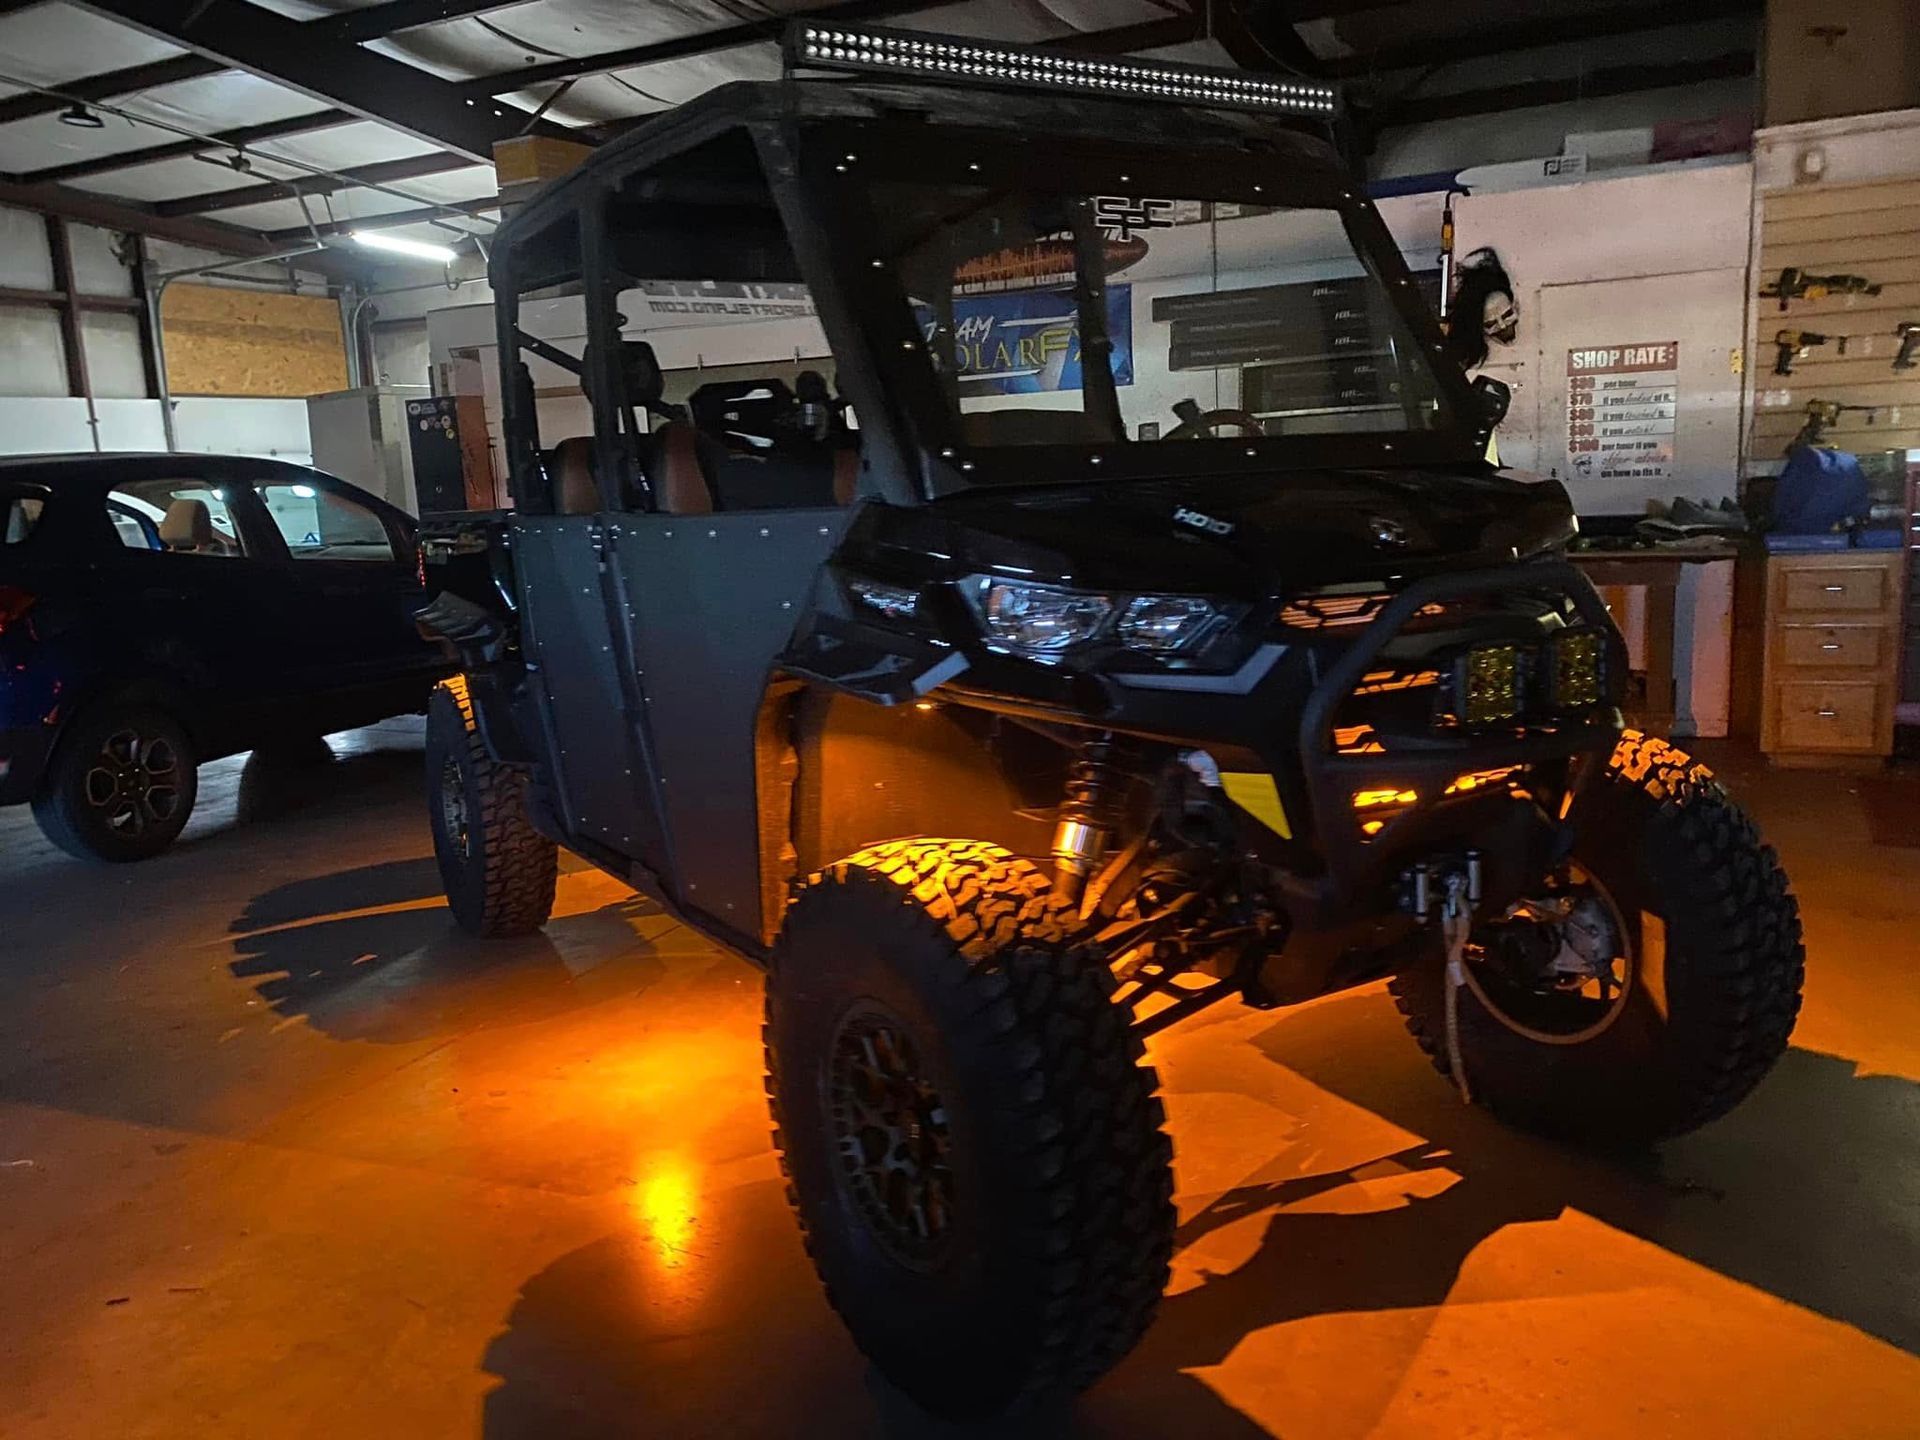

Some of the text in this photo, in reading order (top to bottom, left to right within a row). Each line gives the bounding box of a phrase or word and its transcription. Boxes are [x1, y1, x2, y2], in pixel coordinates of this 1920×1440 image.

[925, 315, 995, 343] TAM
[1572, 346, 1674, 369] SHOP RATE:
[1618, 379, 1637, 387] hour
[1610, 397, 1624, 406] you
[1609, 413, 1624, 422] you
[1602, 444, 1616, 452] per
[1616, 442, 1635, 450] hour
[1643, 442, 1658, 450] you
[1601, 470, 1613, 478] on
[1613, 469, 1632, 477] how
[1632, 468, 1642, 477] to
[1642, 467, 1653, 476] fix
